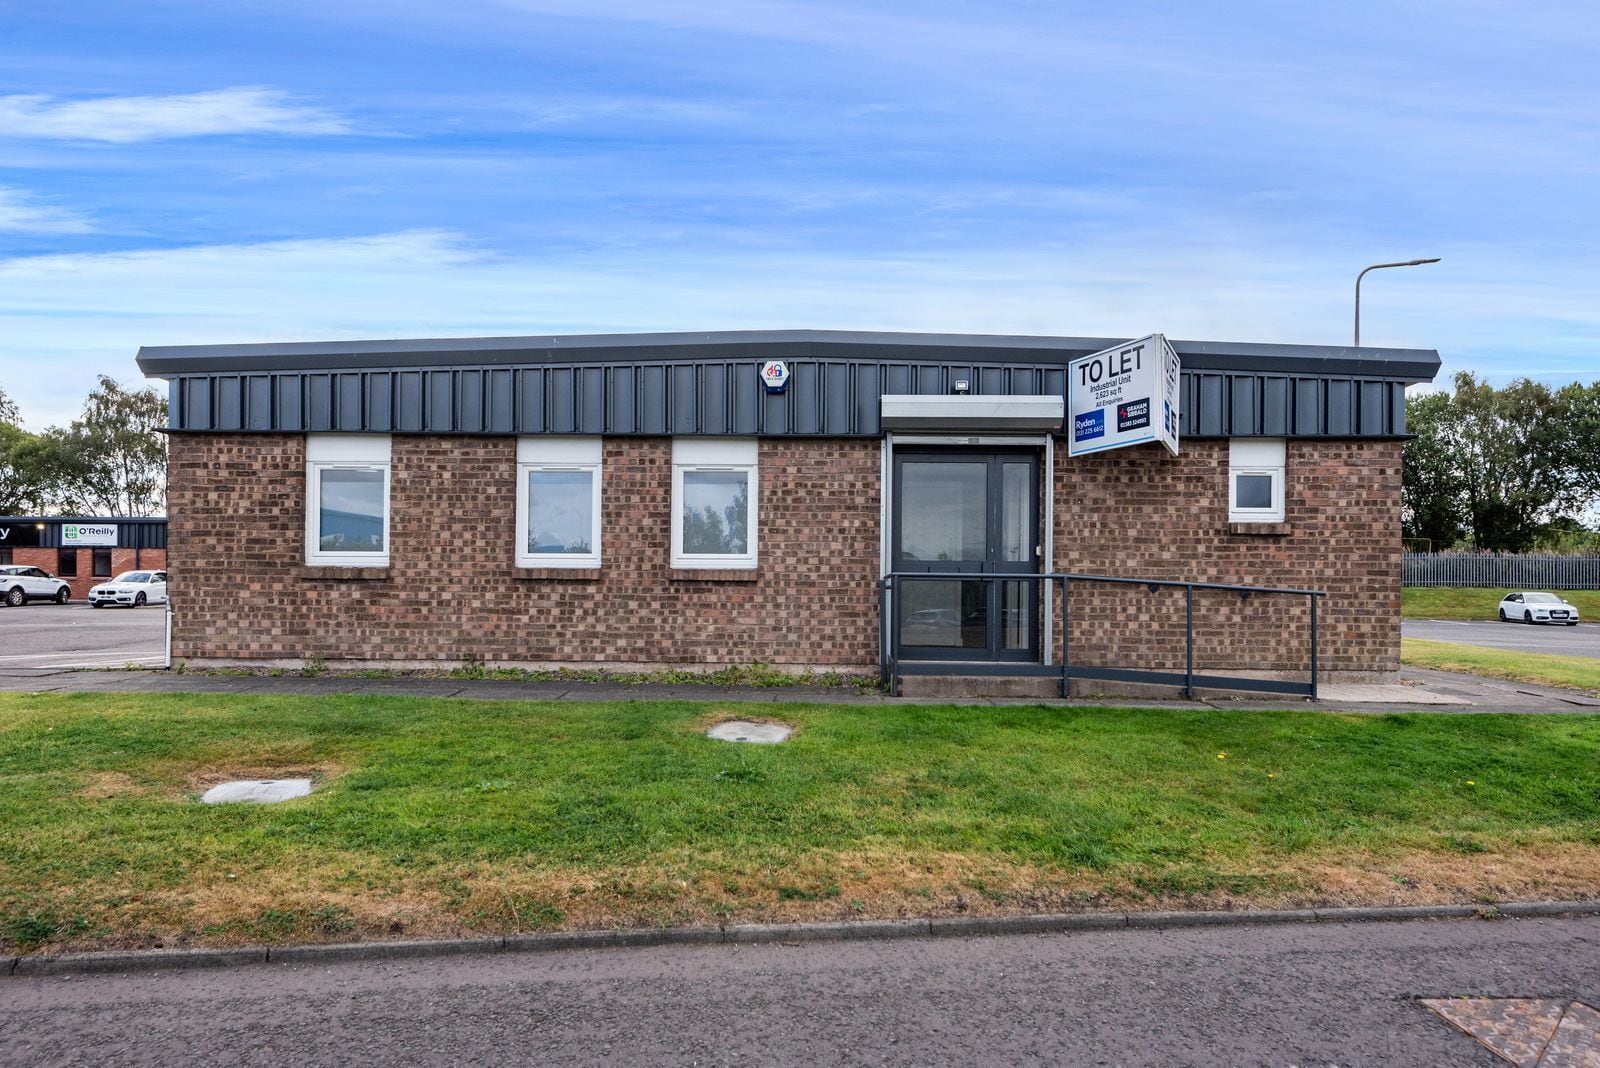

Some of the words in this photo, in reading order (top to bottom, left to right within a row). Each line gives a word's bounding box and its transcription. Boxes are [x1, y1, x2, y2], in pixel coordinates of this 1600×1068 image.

[1079, 360, 1103, 386] TO
[1109, 345, 1145, 378] LET
[1090, 379, 1118, 393] Industrial
[1118, 374, 1131, 385] Unit
[1095, 389, 1109, 399] 2,623
[1102, 397, 1124, 407] Enquiries
[1076, 418, 1096, 430] Ryden
[79, 527, 115, 536] O'Reilly
